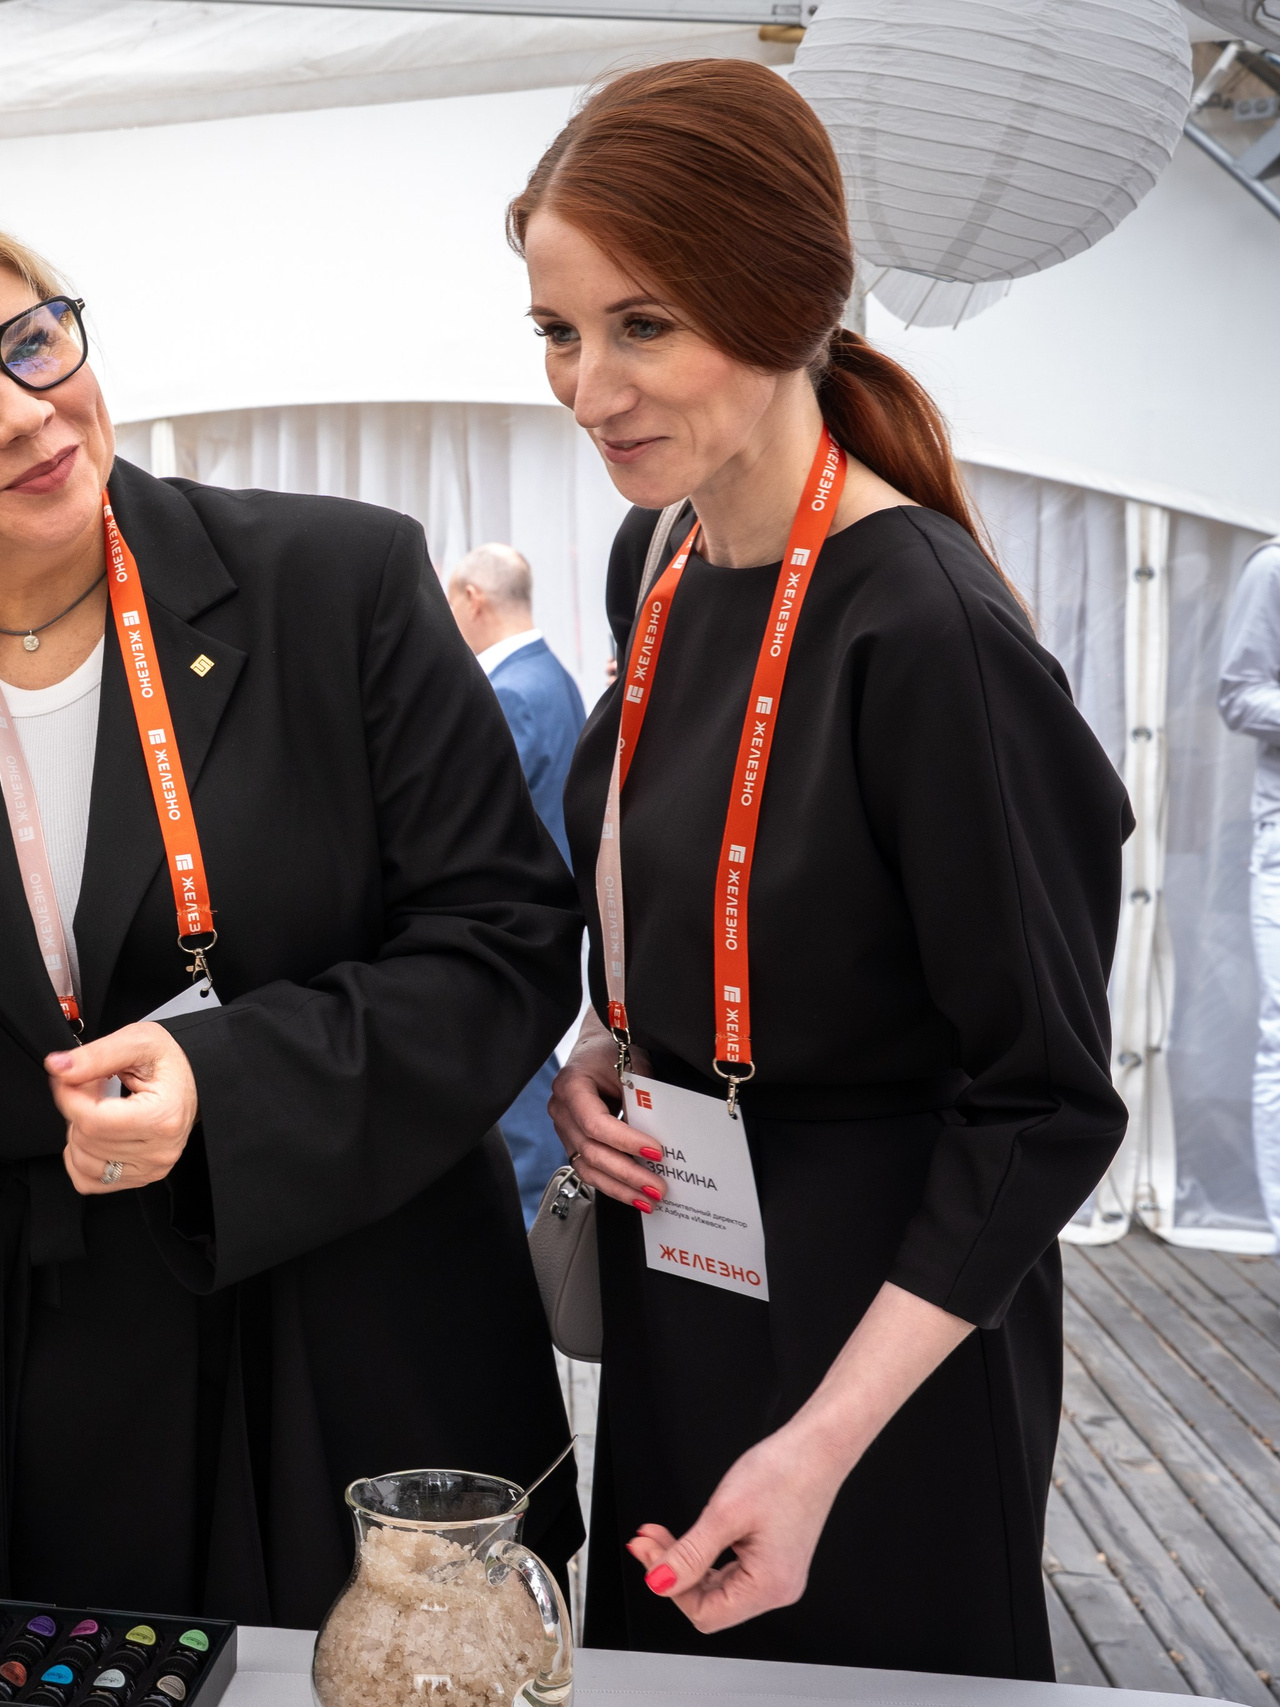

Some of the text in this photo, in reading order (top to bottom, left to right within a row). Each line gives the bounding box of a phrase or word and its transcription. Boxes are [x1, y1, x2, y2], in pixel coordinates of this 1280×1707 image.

[811, 441, 841, 511] ЖЕЛЕЗНО
[108, 519, 128, 583] ЖЕЛЕЗНО
[634, 601, 662, 681] ЖЕЛЕЗНО
[770, 572, 801, 658] ЖЕЛЕЗНО
[128, 630, 154, 699] ЖЕЛЕЗНО
[154, 748, 181, 821] ЖЕЛЕЗНО
[740, 721, 766, 807] ЖЕЛЕЗНО
[181, 876, 202, 935] ЖЕЛЕЗ
[726, 869, 740, 951] ЖЕЛЕЗНО
[659, 1243, 761, 1286] ЖЕЛЕЗНО
